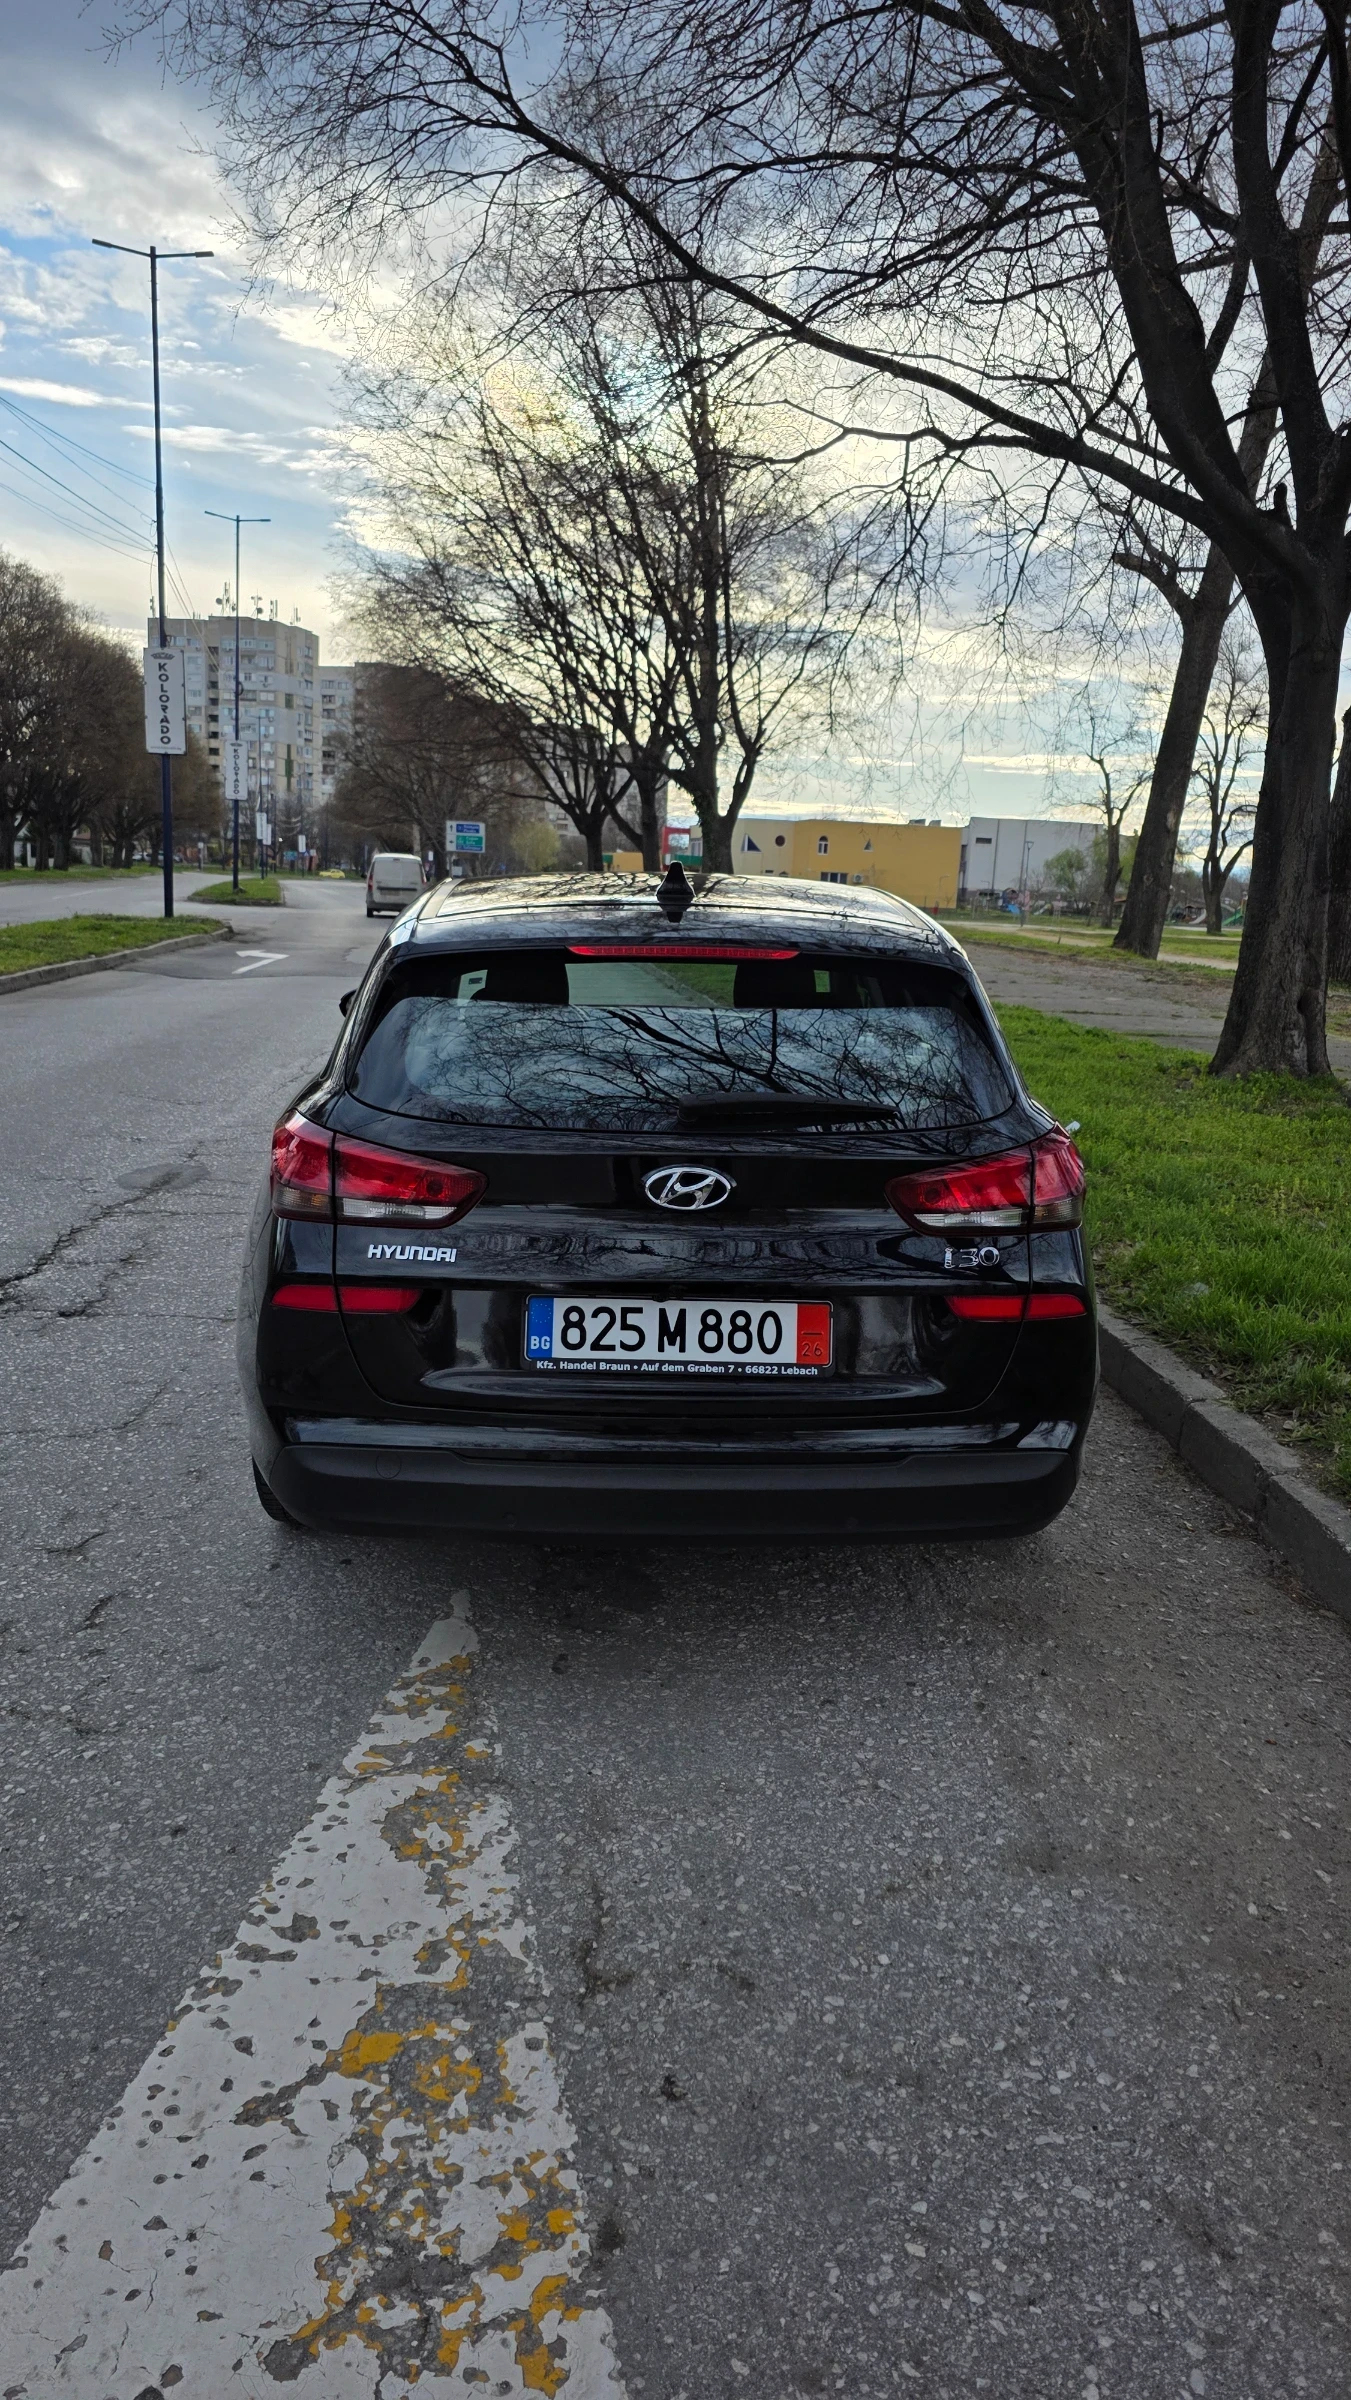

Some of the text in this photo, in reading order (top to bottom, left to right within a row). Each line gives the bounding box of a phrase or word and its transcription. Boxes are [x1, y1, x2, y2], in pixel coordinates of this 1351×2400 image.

[158, 662, 171, 745] KOLORADO
[367, 1244, 458, 1263] HYUNDAI
[530, 1335, 551, 1350] BG
[801, 1341, 824, 1357] 26
[536, 1360, 818, 1376] Kfz. Handel Braun Auf dem Graben 7 66822 Lebach
